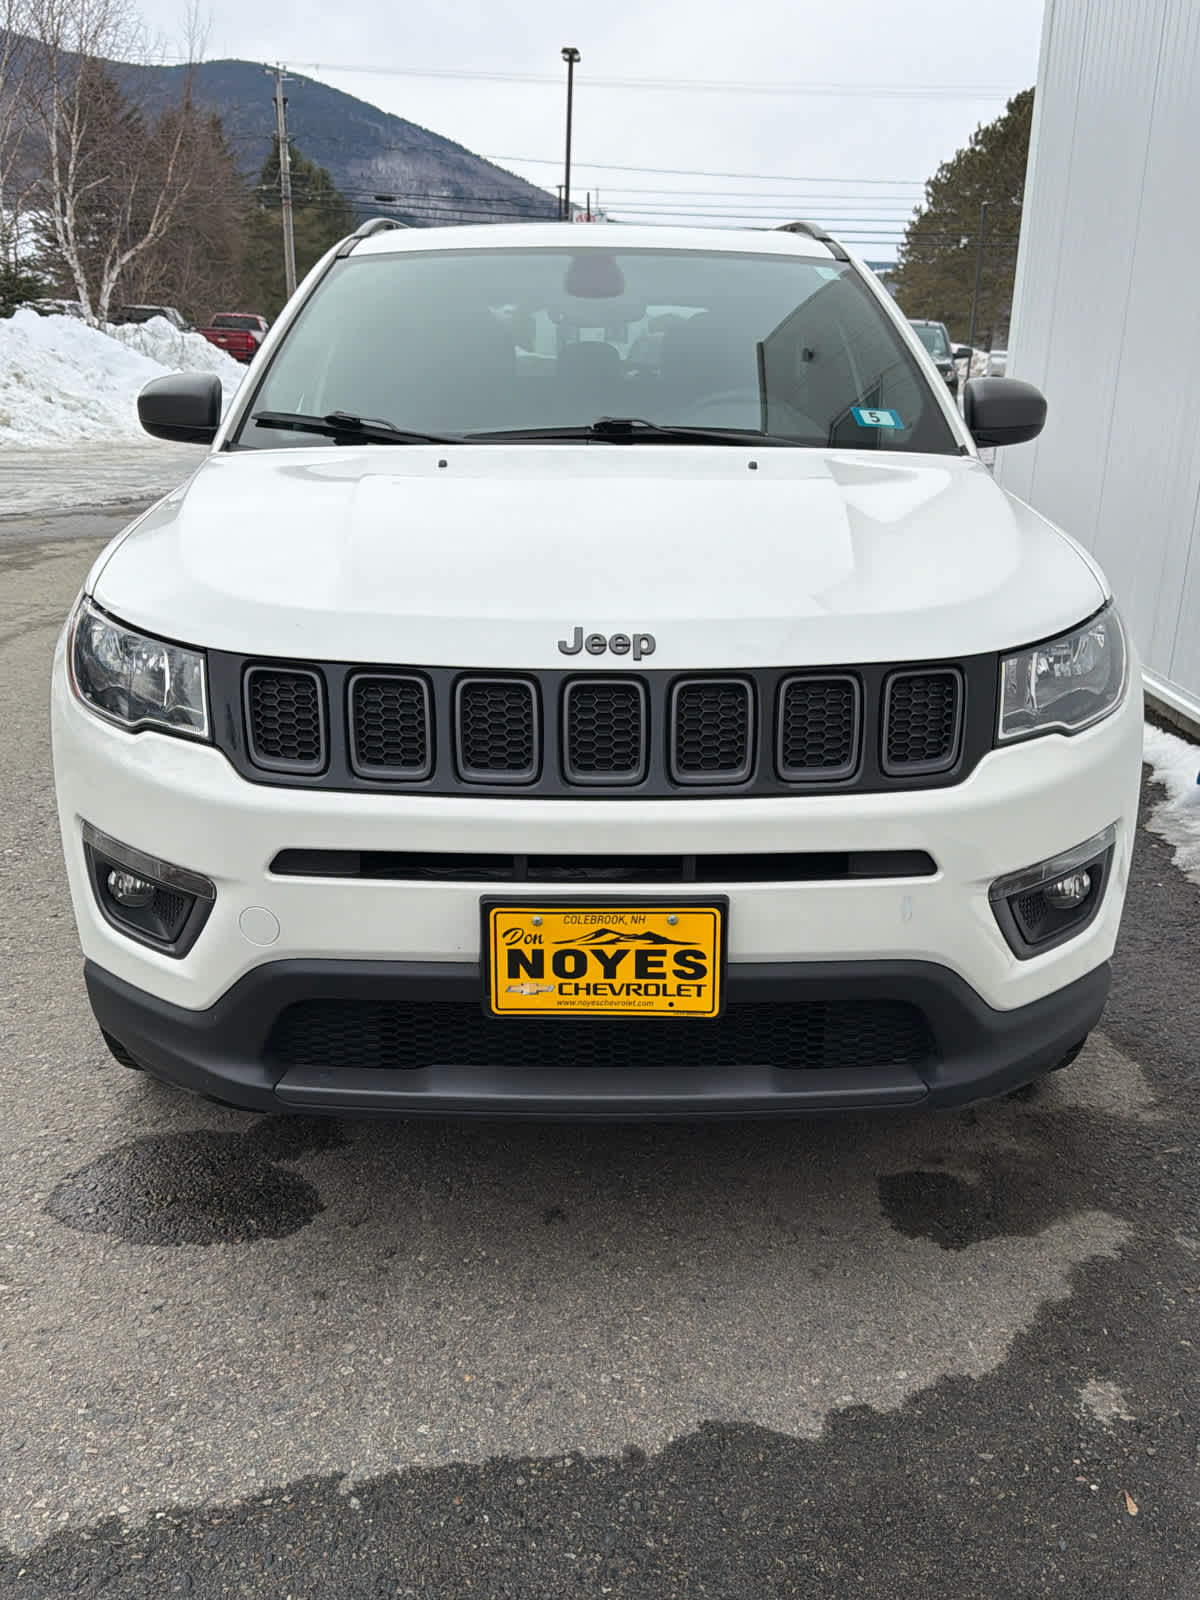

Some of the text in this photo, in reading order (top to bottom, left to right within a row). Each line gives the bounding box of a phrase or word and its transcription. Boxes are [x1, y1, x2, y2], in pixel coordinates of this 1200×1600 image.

[868, 411, 881, 423] 5
[557, 626, 657, 661] Jeep
[563, 915, 646, 926] COLEBROOK, NH
[502, 927, 545, 946] Don
[507, 948, 708, 980] NOYES
[558, 982, 707, 997] CHEVROLET
[557, 999, 654, 1007] www.noyeschevrolet.com
